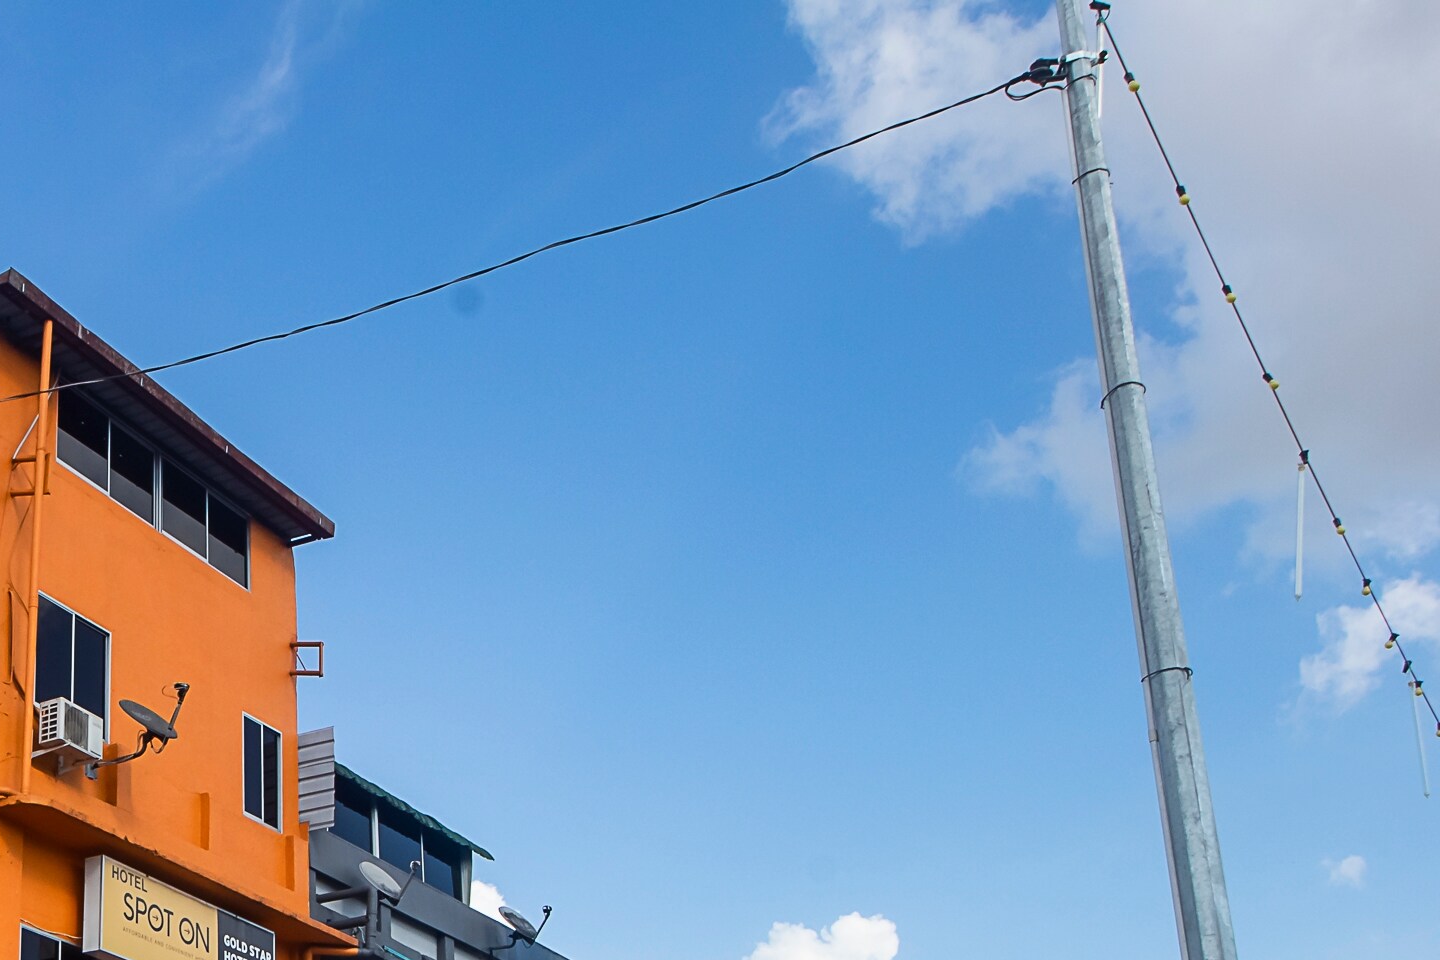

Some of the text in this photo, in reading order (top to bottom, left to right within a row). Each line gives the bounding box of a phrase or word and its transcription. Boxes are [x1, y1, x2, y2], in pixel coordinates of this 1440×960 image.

[112, 865, 148, 893] HOTEL
[123, 892, 210, 953] SPOT ON
[223, 934, 248, 954] GOLD
